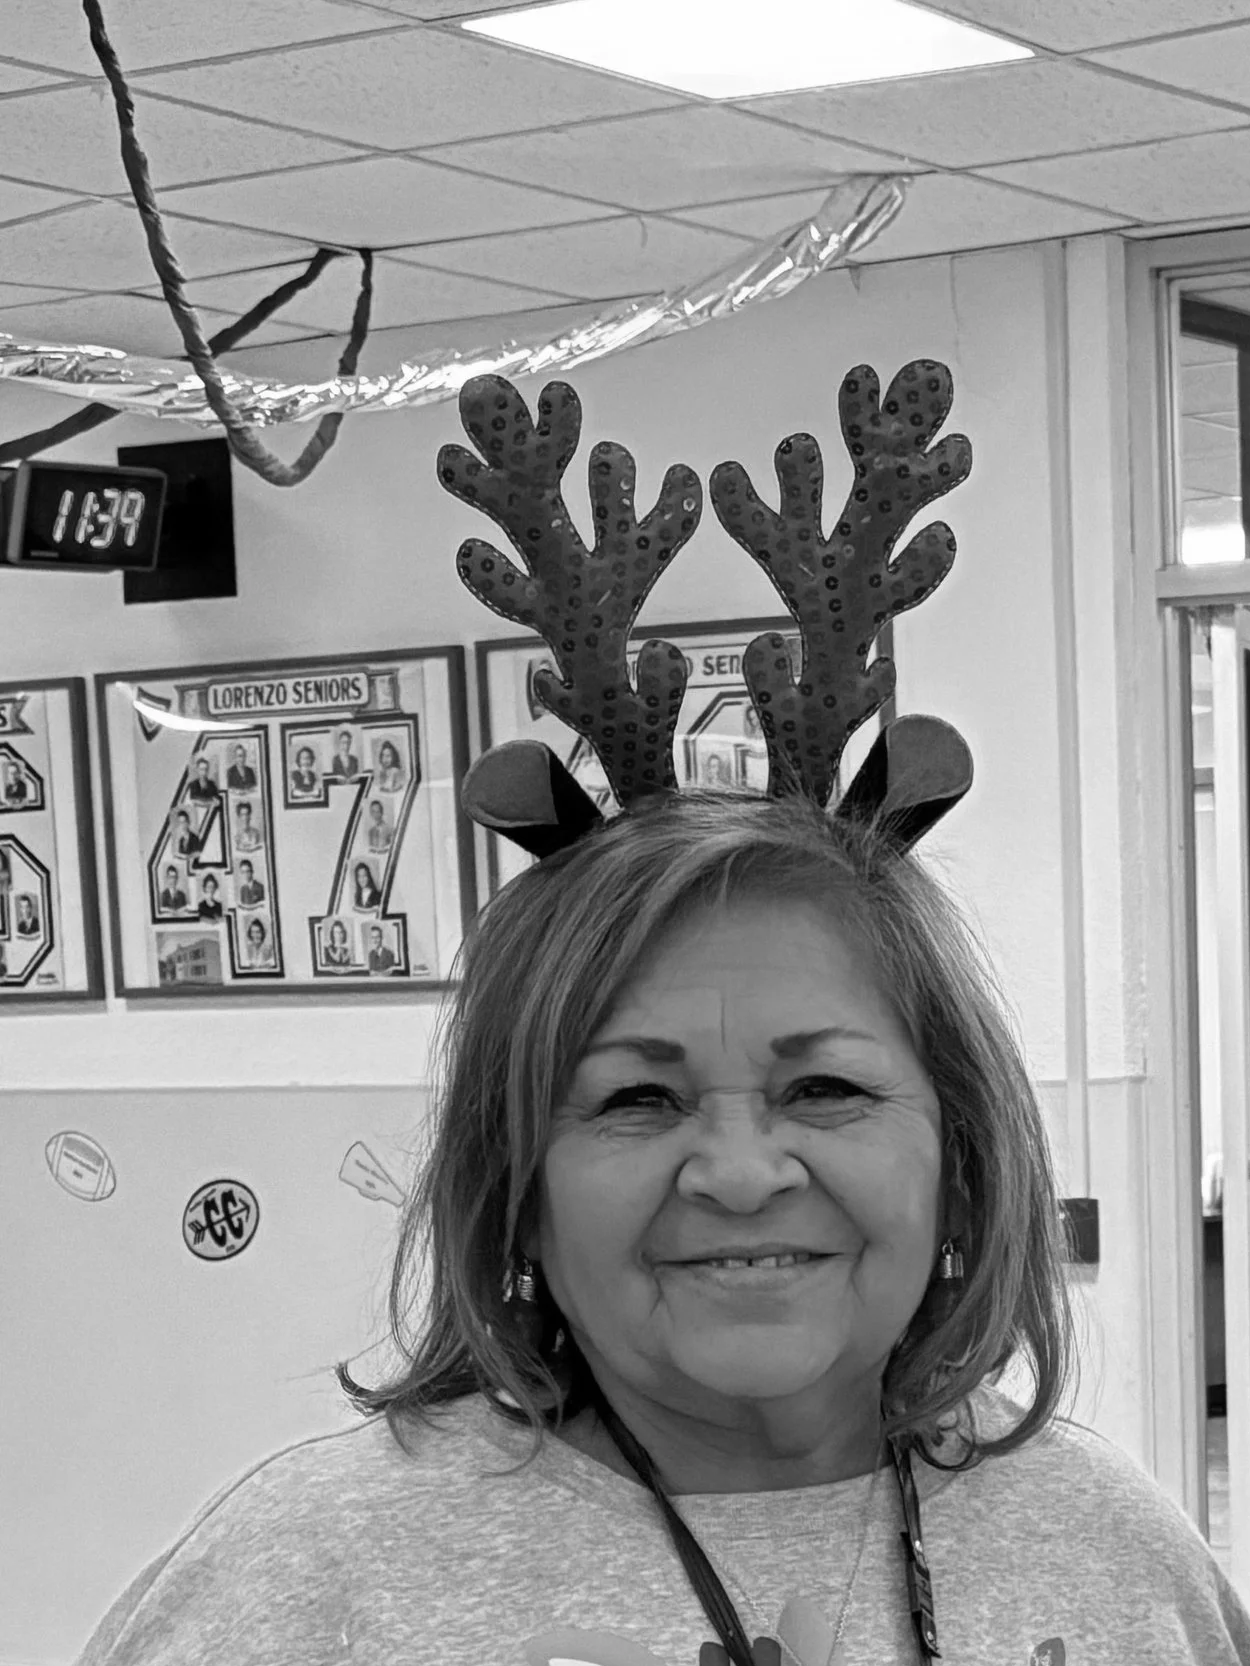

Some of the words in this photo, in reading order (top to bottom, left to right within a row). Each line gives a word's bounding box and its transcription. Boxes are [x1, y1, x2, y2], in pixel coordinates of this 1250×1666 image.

[53, 488, 146, 549] 11:39
[213, 683, 287, 710] LORENZO
[291, 677, 362, 704] SENIORS
